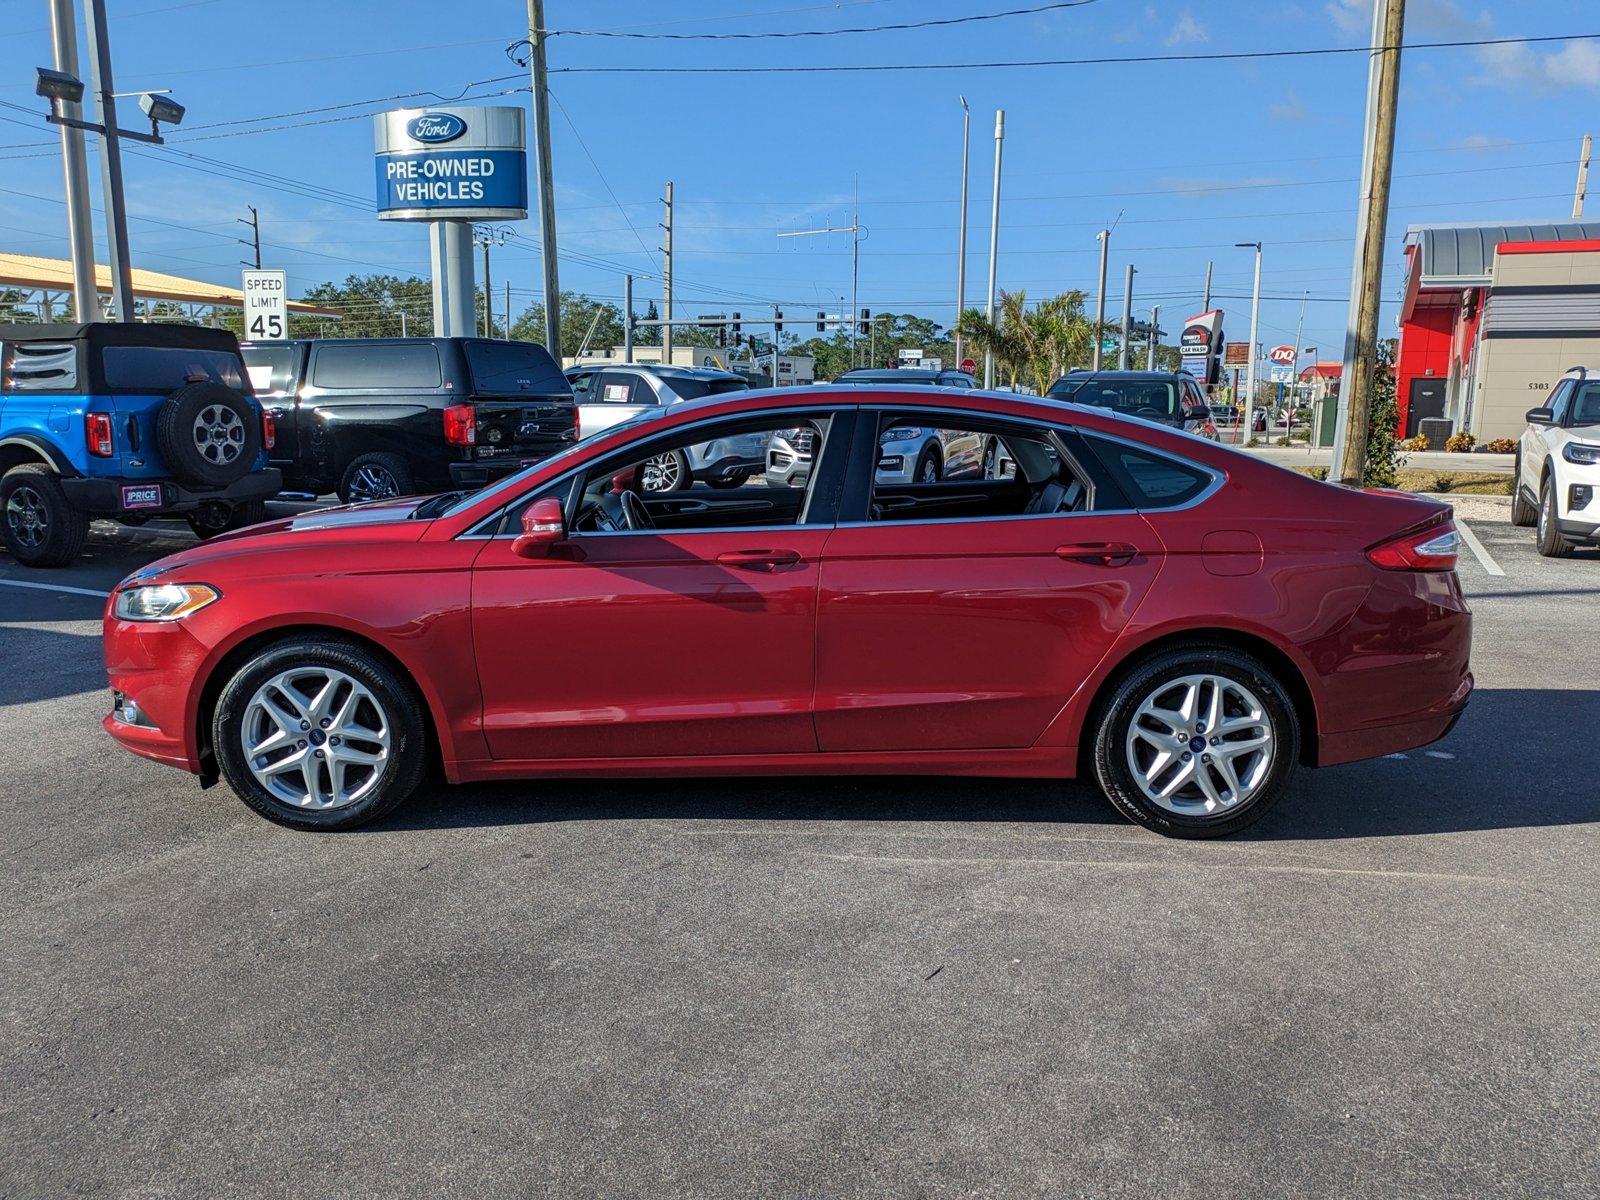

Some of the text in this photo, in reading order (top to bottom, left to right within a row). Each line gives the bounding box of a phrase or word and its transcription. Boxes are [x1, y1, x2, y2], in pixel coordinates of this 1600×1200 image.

[415, 117, 451, 137] Ford
[387, 158, 495, 180] PRE-OWNED
[396, 181, 484, 201] VEHICLES
[247, 279, 282, 290] SPEED
[251, 297, 278, 308] LIMIT
[250, 314, 283, 338] 45
[1274, 350, 1295, 361] DQ
[961, 365, 976, 374] STOP
